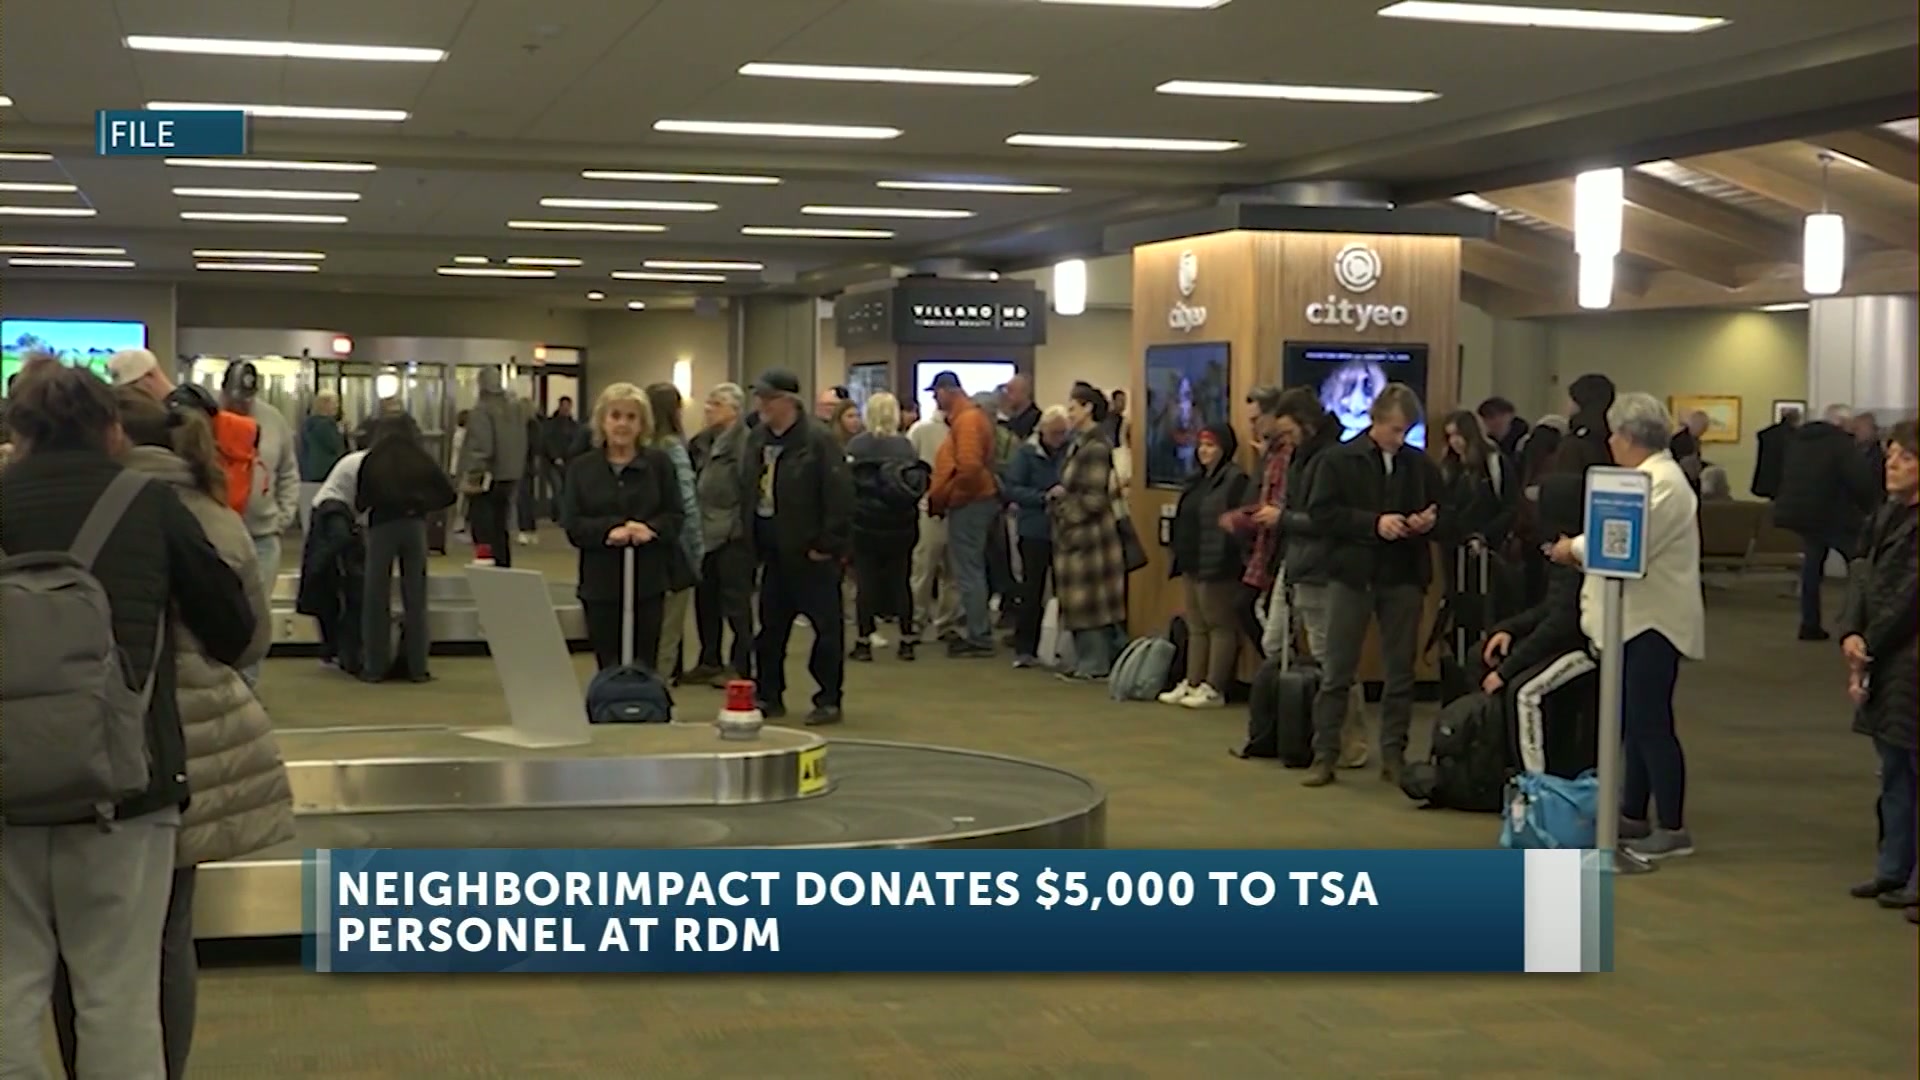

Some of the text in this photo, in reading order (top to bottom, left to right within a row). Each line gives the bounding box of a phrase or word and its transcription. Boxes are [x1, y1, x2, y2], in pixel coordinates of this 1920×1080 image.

[913, 305, 1028, 319] VILLANO MD
[1305, 295, 1409, 331] cityeo
